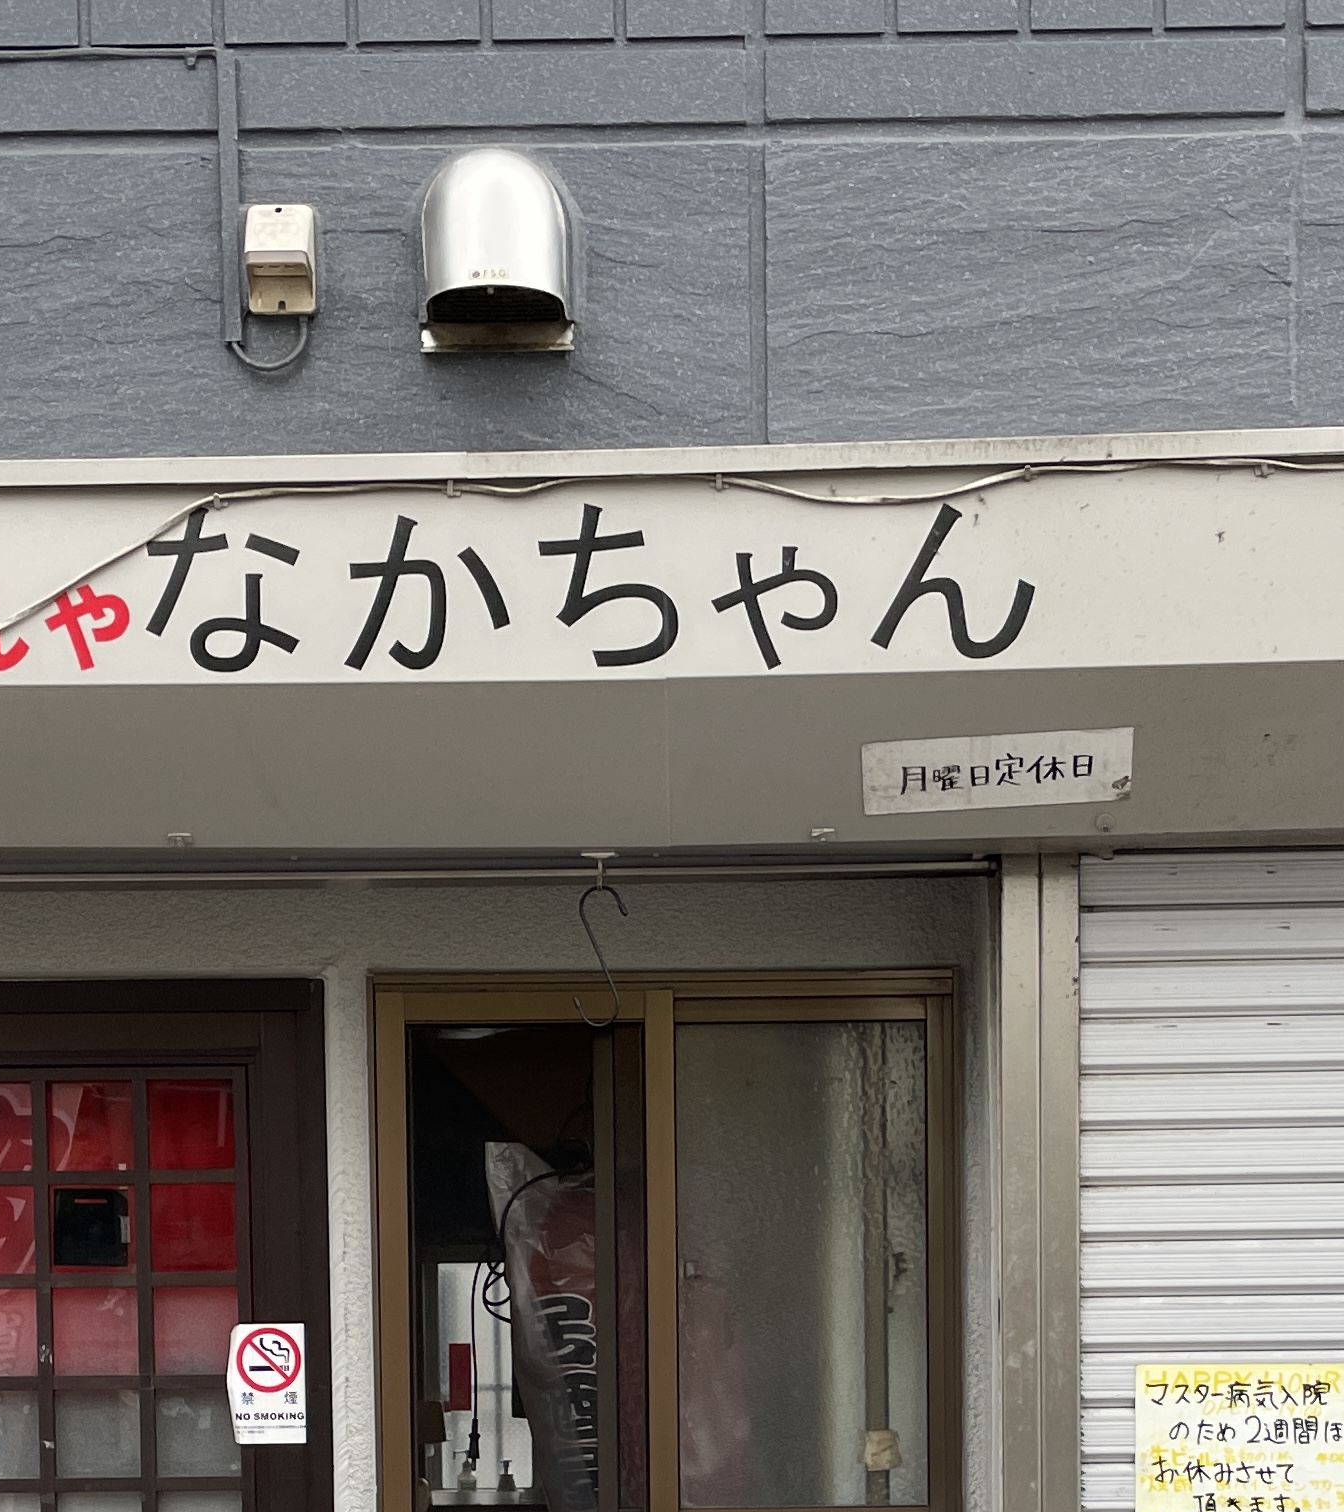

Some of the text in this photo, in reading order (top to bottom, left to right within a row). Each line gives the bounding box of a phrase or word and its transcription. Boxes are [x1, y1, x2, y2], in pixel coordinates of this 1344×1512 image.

[146, 503, 1036, 672] なかちゃん
[900, 753, 1093, 795] 月曜日定休日
[1146, 1380, 1331, 1410] マスター病気入院
[236, 1412, 305, 1421] NO SMOKING
[1151, 1456, 1296, 1485] お休みさせて
